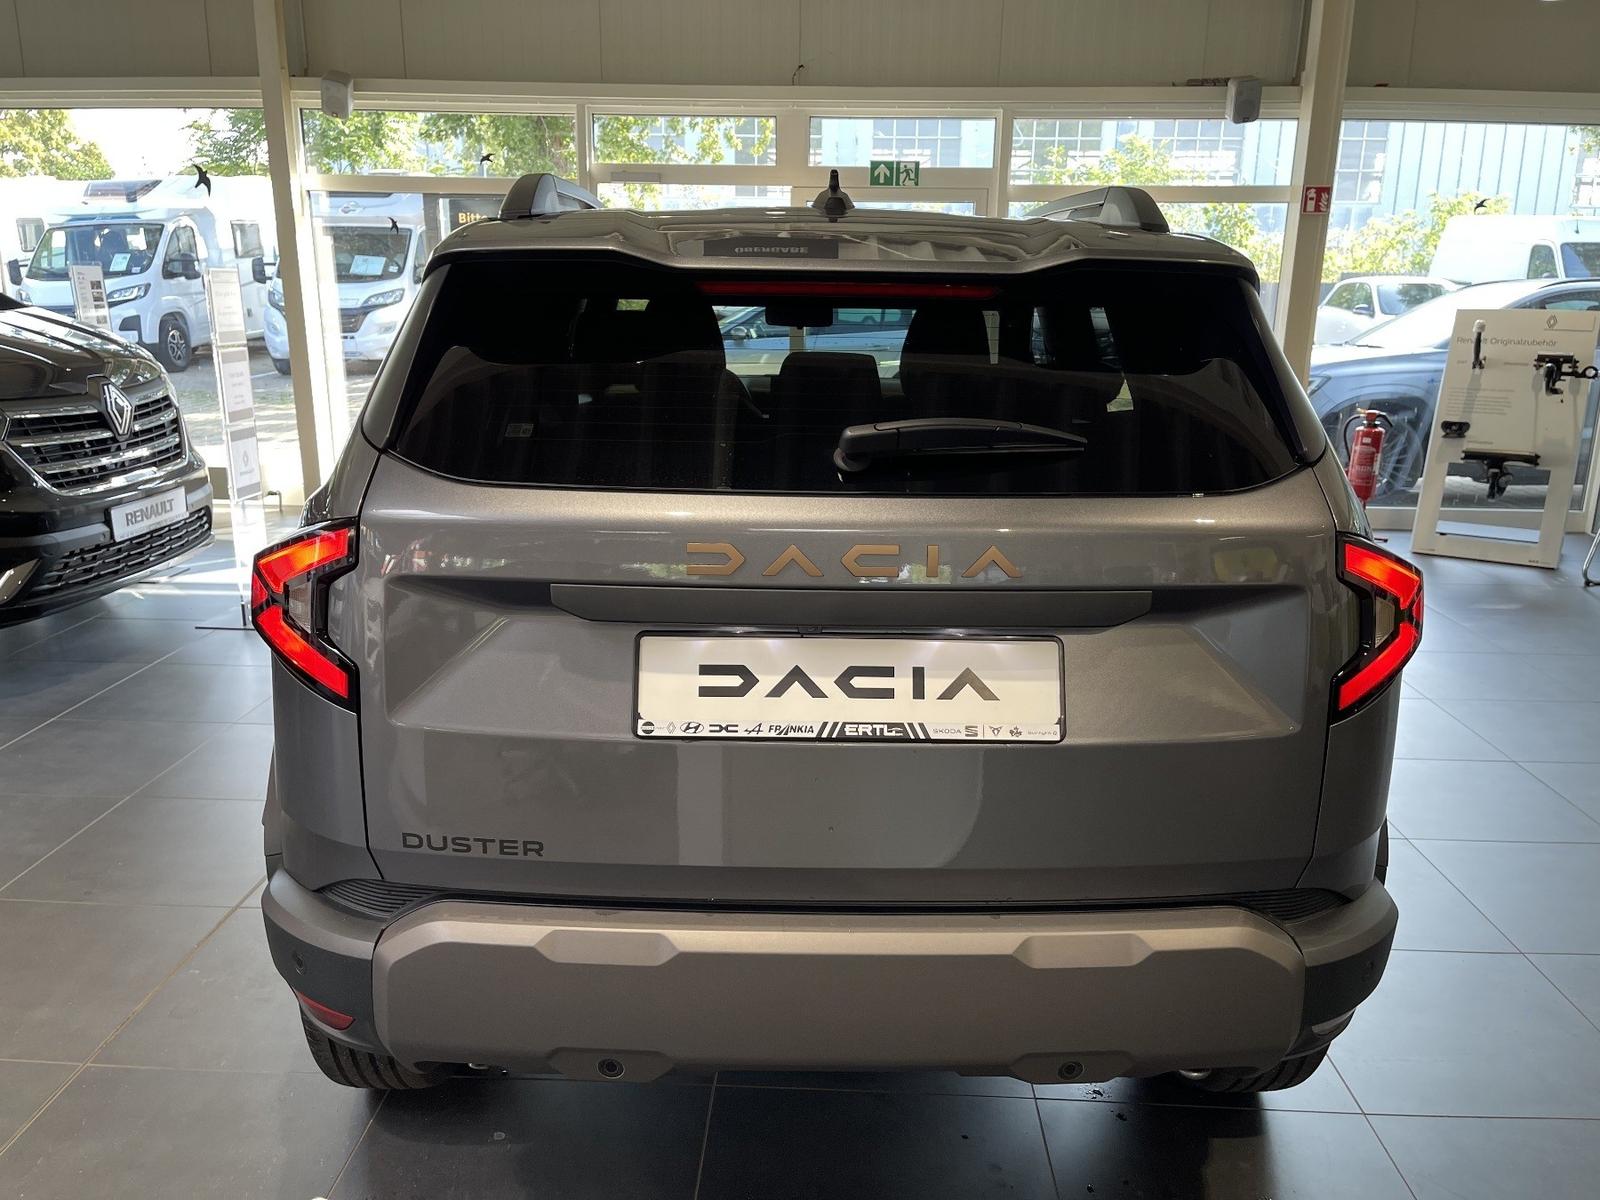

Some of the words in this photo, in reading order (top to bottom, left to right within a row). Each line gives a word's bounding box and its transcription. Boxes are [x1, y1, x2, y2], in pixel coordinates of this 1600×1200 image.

[1490, 337, 1557, 347] Originalzubehör
[125, 498, 175, 527] RENAULT
[686, 542, 1023, 578] DACIA
[698, 664, 1001, 702] DACIA
[767, 724, 814, 736] FRANKIA
[402, 832, 544, 857] DUSTER
